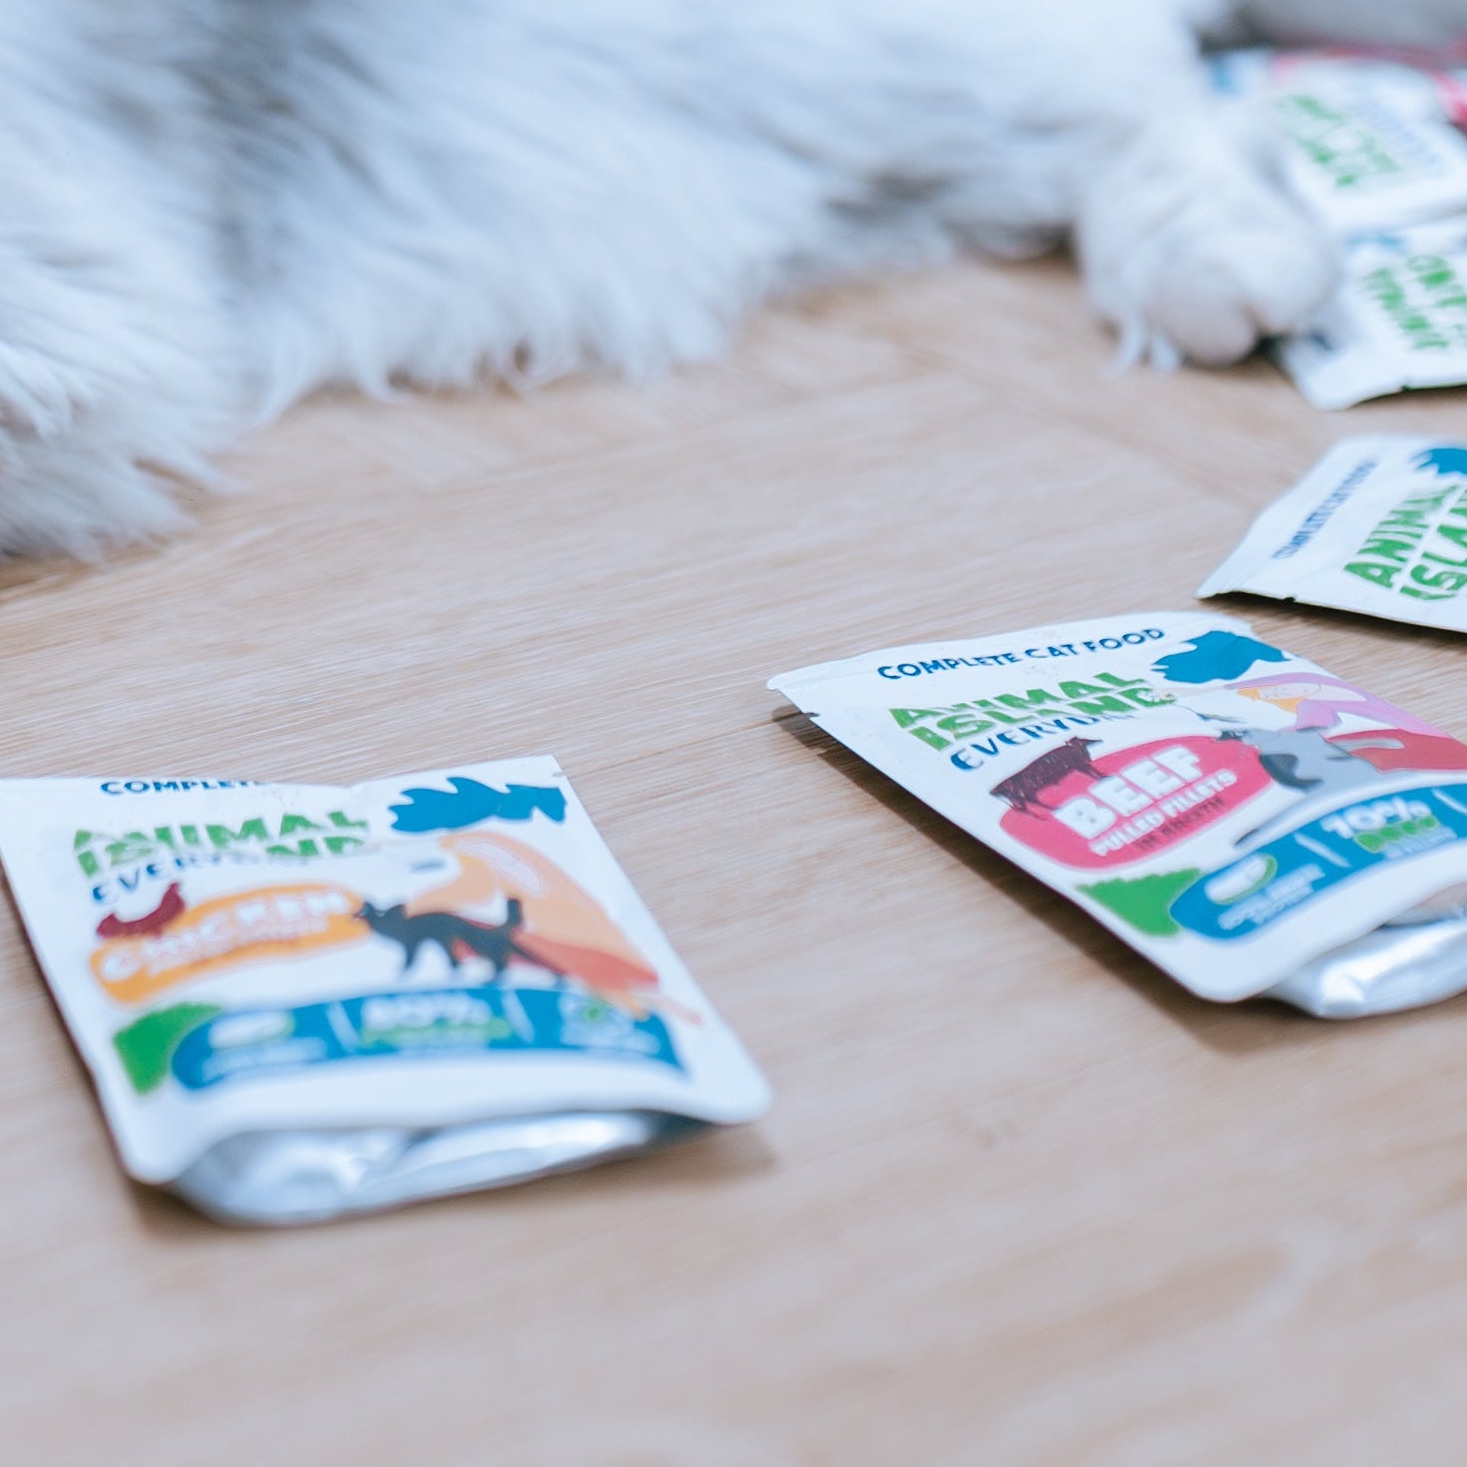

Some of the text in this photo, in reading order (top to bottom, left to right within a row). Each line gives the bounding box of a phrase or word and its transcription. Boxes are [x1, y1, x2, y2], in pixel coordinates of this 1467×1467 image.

[1399, 485, 1467, 601] ISLA
[877, 627, 1166, 680] COMPLETE CAT FOOD
[889, 671, 1146, 729] ANIMAL
[100, 781, 269, 795] COMPLE
[1051, 744, 1203, 840] BEEF
[77, 836, 364, 877] ISND
